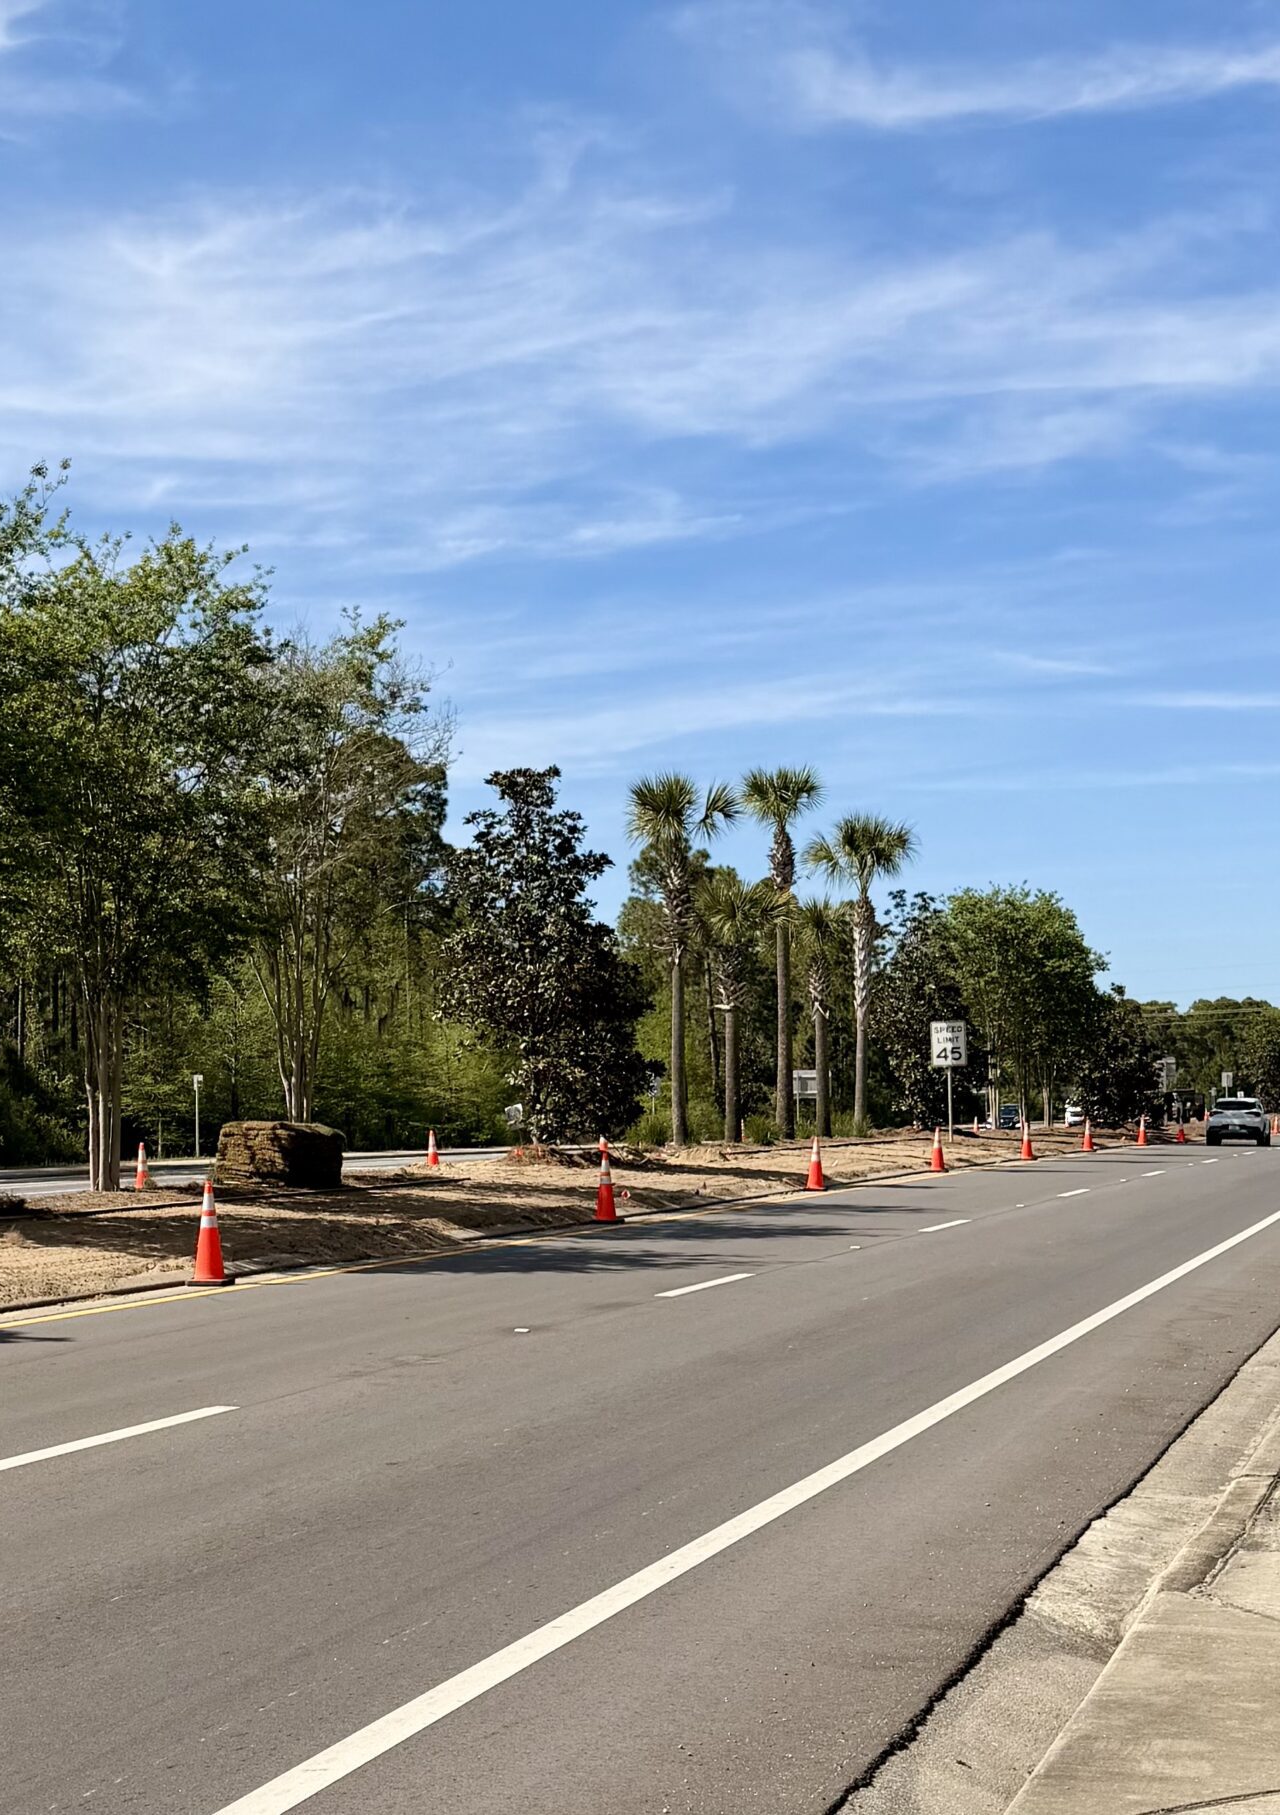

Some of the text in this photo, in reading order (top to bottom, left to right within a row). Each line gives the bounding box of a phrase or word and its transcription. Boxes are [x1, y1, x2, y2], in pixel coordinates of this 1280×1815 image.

[933, 1025, 963, 1033] SPEED
[937, 1035, 959, 1044] LIMIT
[936, 1046, 962, 1061] 45
